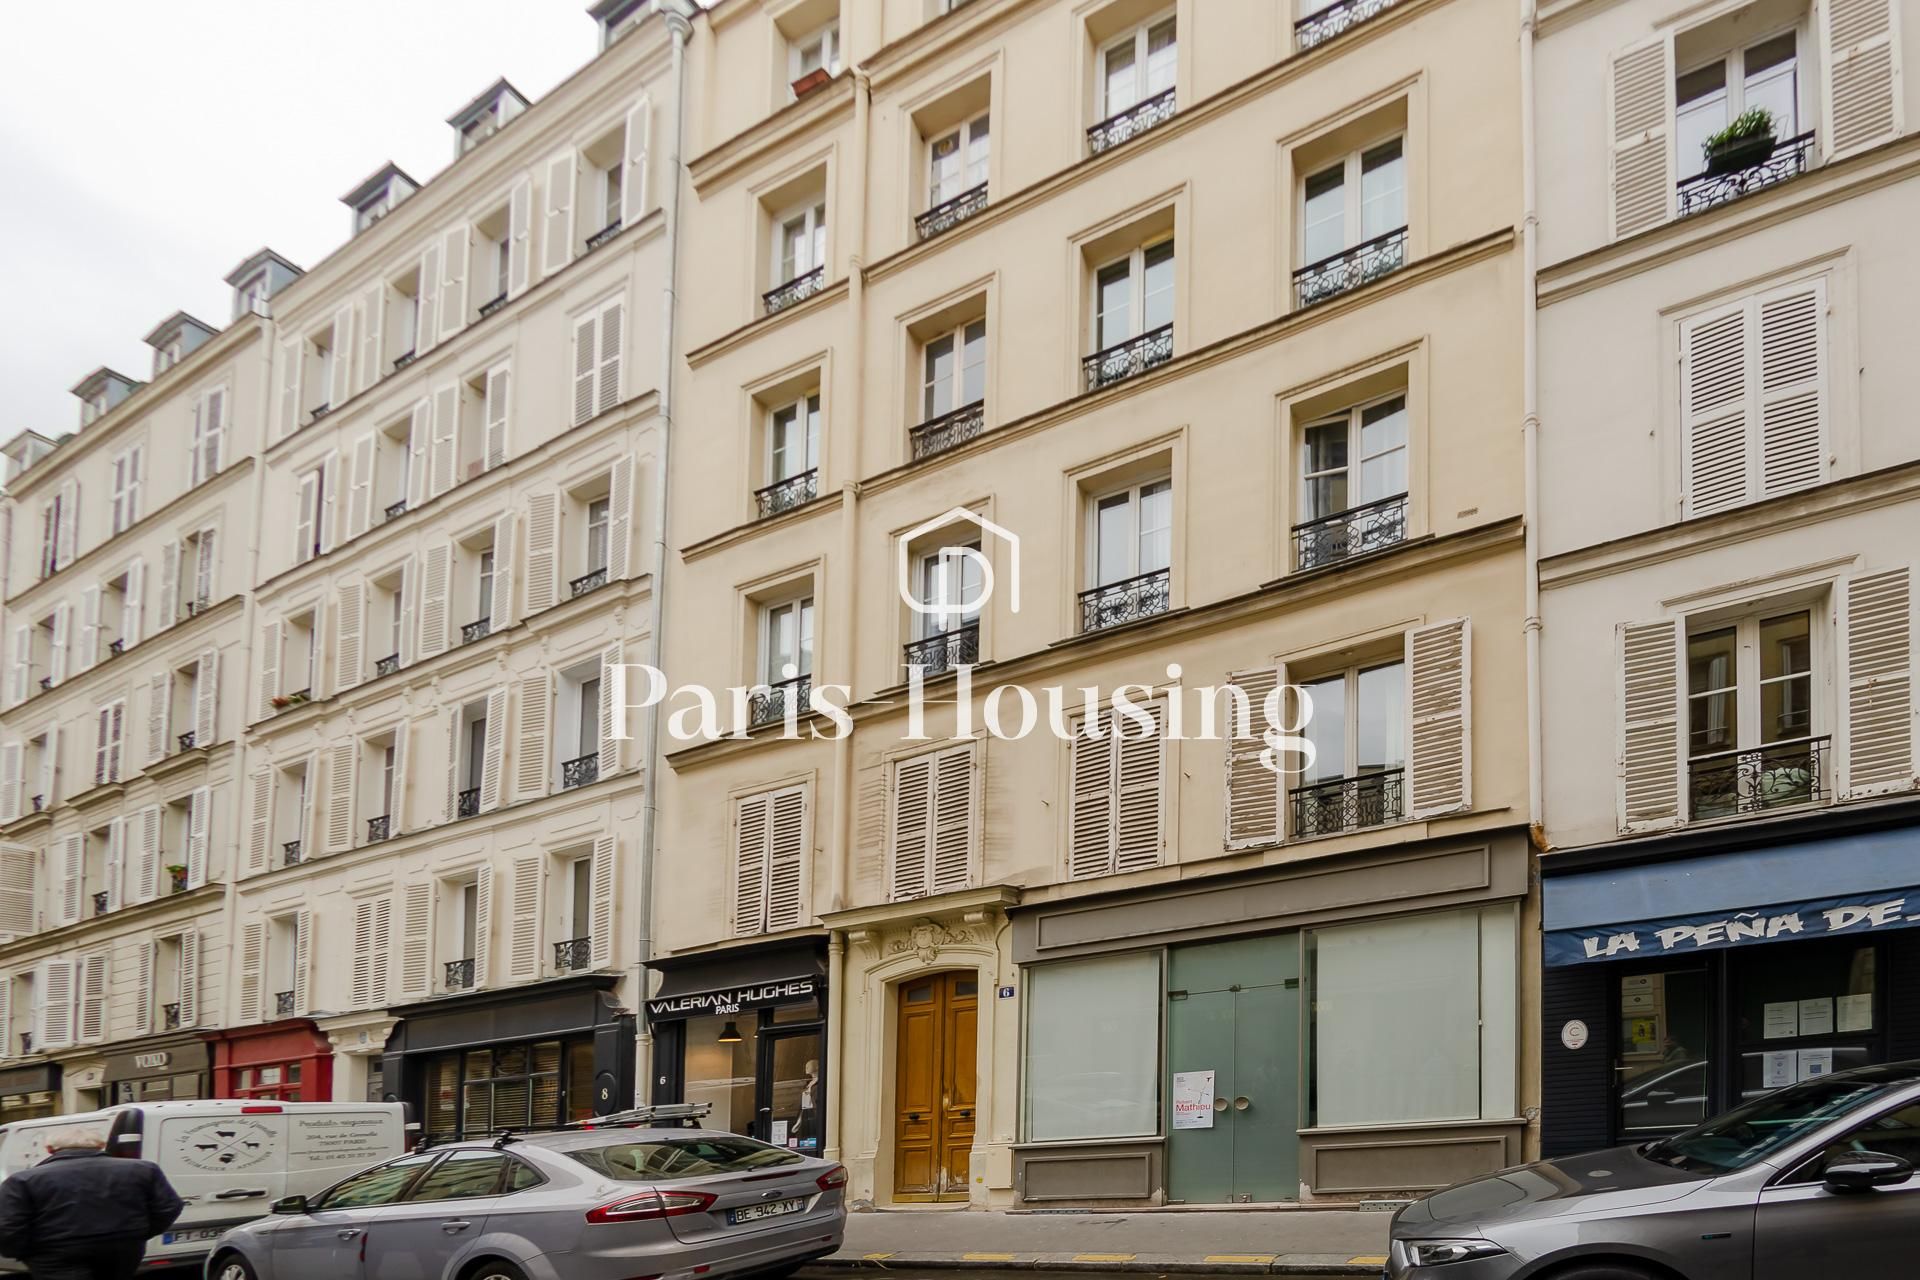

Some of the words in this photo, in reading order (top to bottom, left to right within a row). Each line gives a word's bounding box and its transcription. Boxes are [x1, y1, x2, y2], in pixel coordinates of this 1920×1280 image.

[1583, 931, 1640, 958] LA
[1654, 911, 1804, 950] PEÑA
[1822, 898, 1905, 932] DE
[650, 992, 732, 1014] VALERIAN
[737, 981, 813, 1003] HUGHES
[715, 1003, 740, 1015] PARIS
[660, 1076, 666, 1085] 6
[602, 1088, 608, 1100] 8
